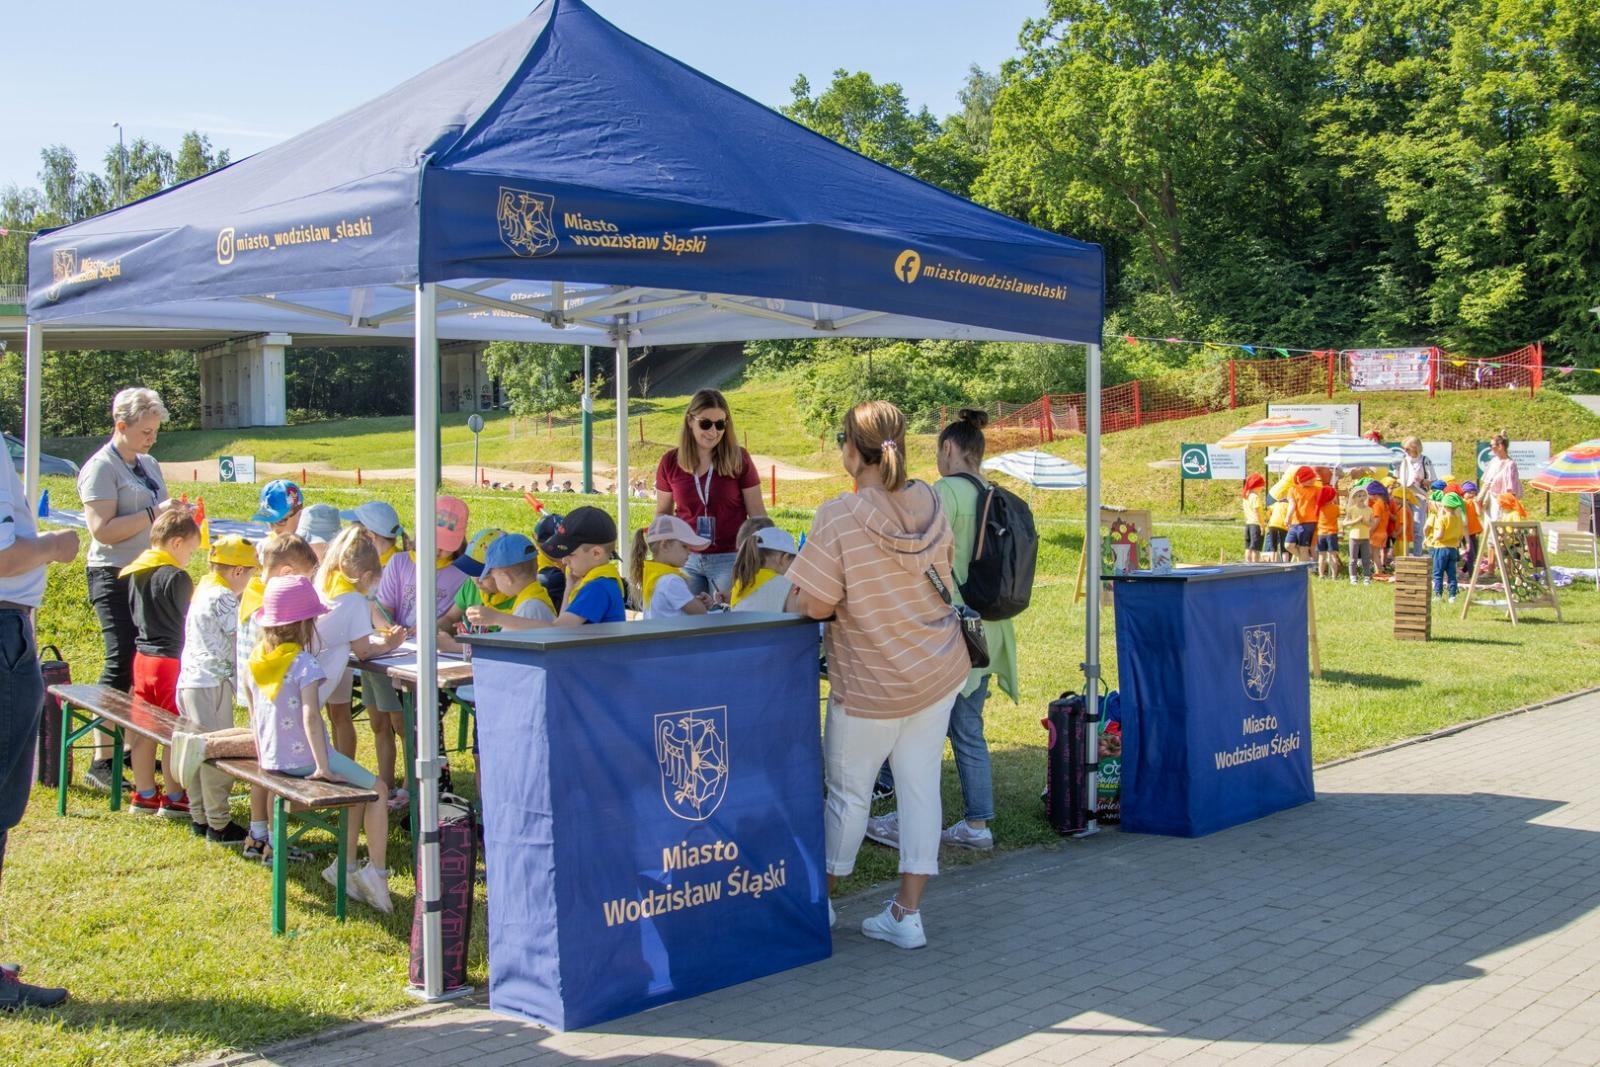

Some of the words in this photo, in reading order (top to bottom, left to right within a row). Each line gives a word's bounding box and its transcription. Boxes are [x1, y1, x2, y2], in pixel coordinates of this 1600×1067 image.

[236, 216, 372, 251] miasto_wodzislaw_slaski
[564, 212, 619, 232] Miasto
[569, 233, 659, 250] Wodzisław
[662, 232, 707, 256] Śląski
[923, 263, 1068, 300] miastowodzislawslaski
[1242, 714, 1278, 735] Miasto
[1215, 742, 1270, 770] Wodzisław
[1271, 730, 1300, 758] Śląski
[662, 839, 739, 873] Miasto
[603, 880, 722, 927] Wodzisław
[727, 859, 786, 899] Śląski
